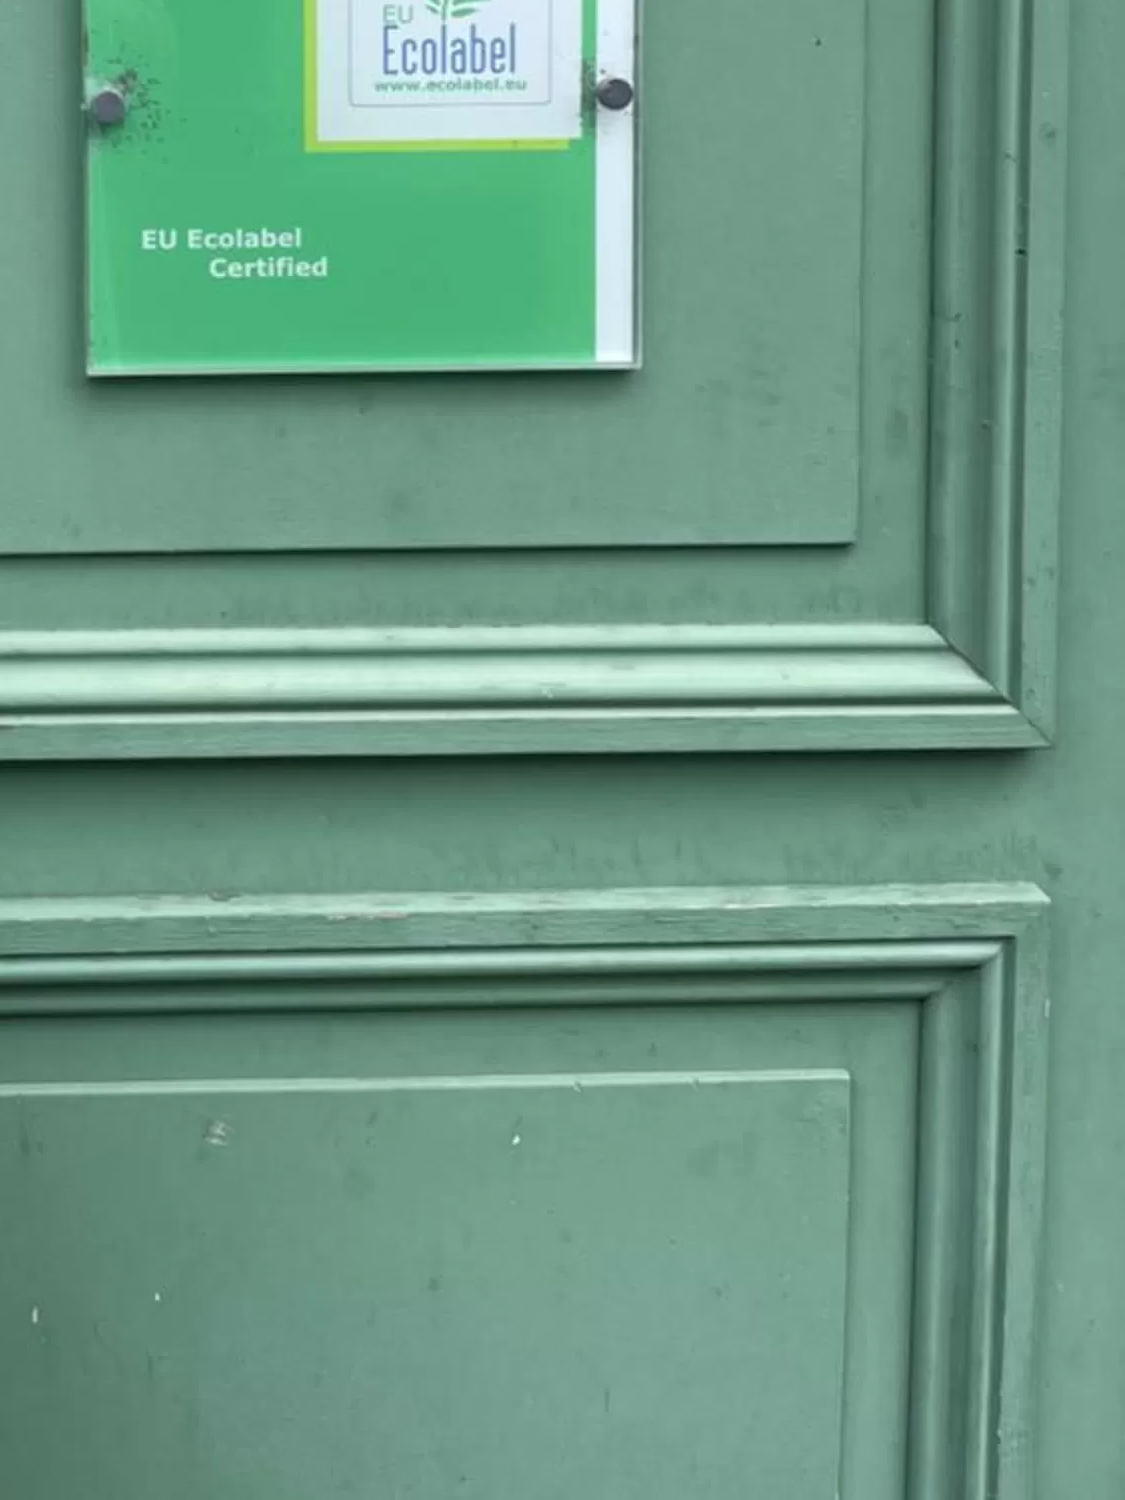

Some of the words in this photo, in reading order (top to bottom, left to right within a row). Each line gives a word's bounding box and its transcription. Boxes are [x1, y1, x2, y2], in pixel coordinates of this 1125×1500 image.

[383, 4, 414, 24] EU
[383, 22, 516, 75] Ecolabel
[375, 77, 527, 93] www.ecolabel.eu
[141, 229, 177, 249] EU
[187, 227, 302, 249] Ecolabel
[208, 256, 328, 278] Certified
